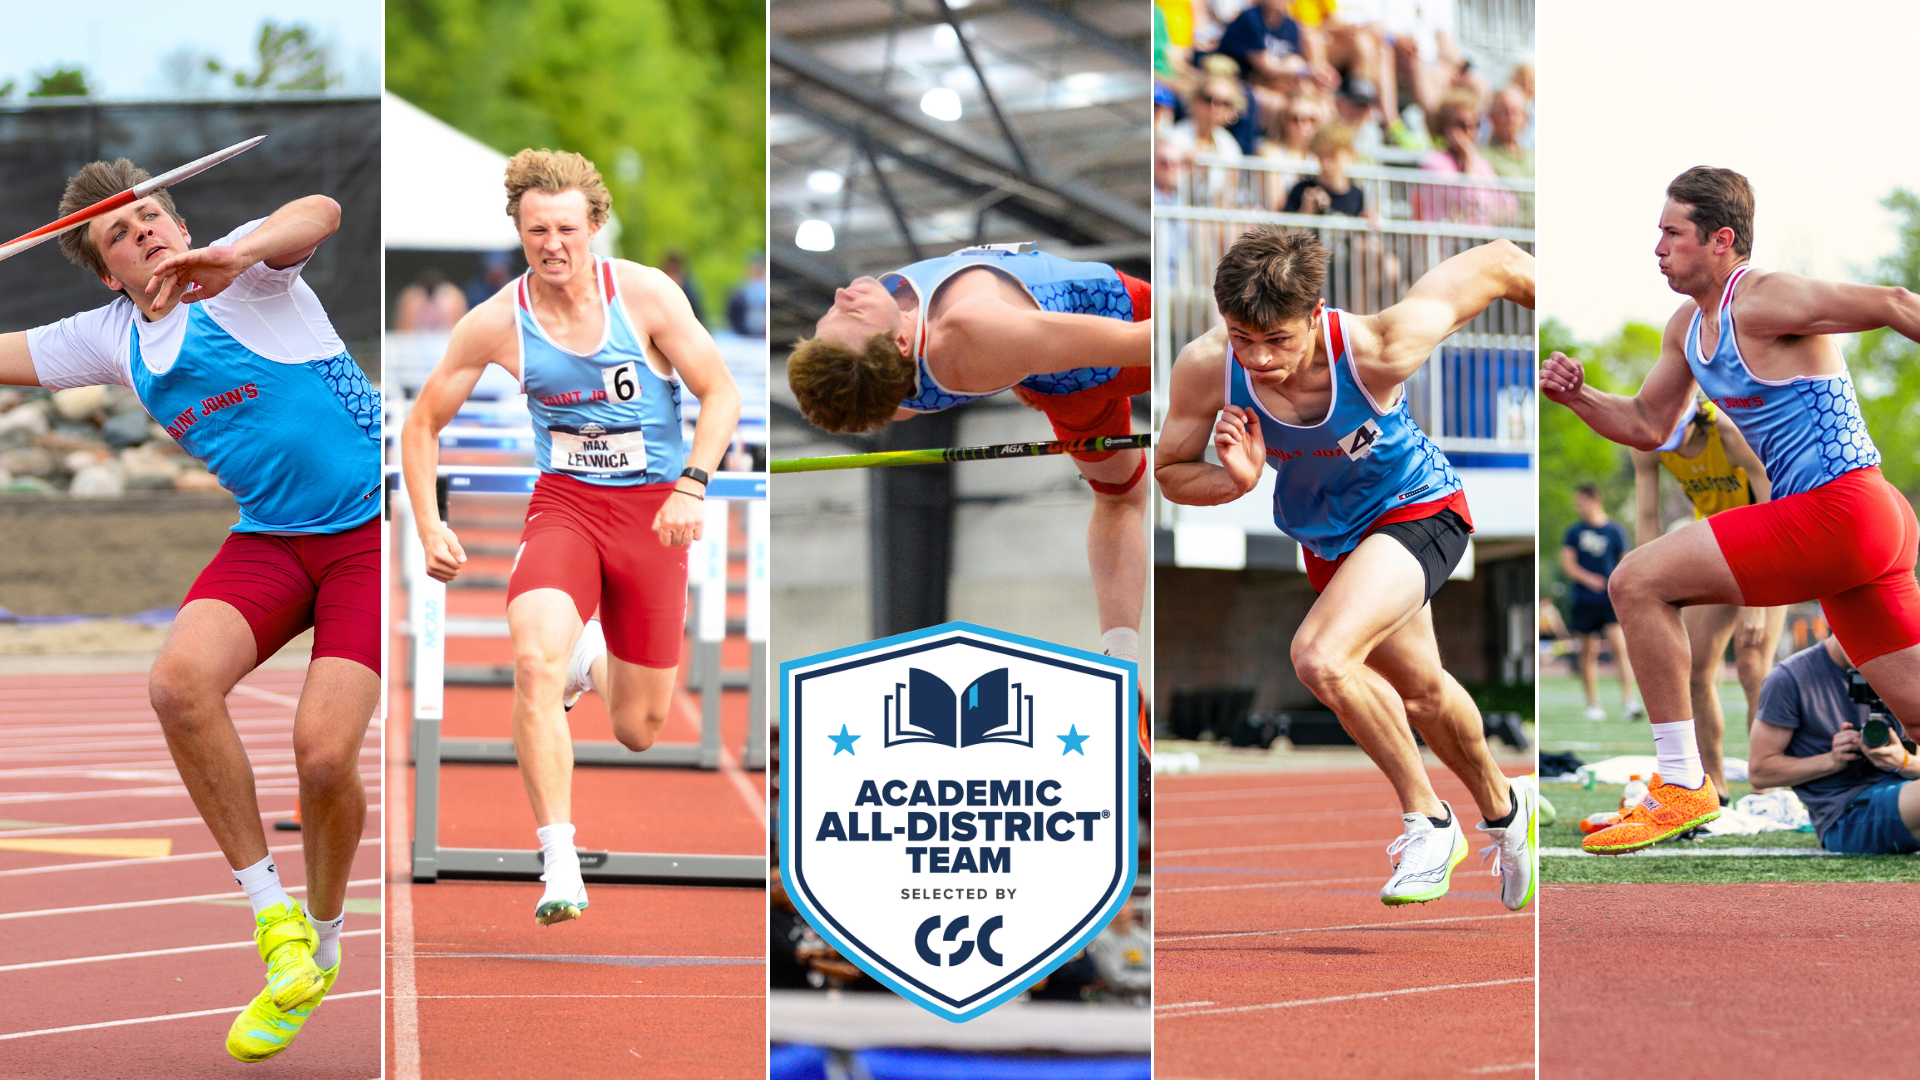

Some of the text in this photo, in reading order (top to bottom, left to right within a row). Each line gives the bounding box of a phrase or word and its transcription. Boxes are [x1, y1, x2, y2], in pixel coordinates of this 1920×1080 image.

[614, 366, 634, 401] 6
[200, 382, 259, 416] JOHN'S
[540, 390, 582, 407] SAINT
[1723, 396, 1765, 409] JOHN'S
[582, 440, 609, 451] MAX
[1350, 425, 1377, 454] 4
[1001, 444, 1024, 454] AGX
[1265, 447, 1347, 462] AINT JOH
[567, 452, 629, 468] LELWICA
[1641, 796, 1661, 811] NIKE
